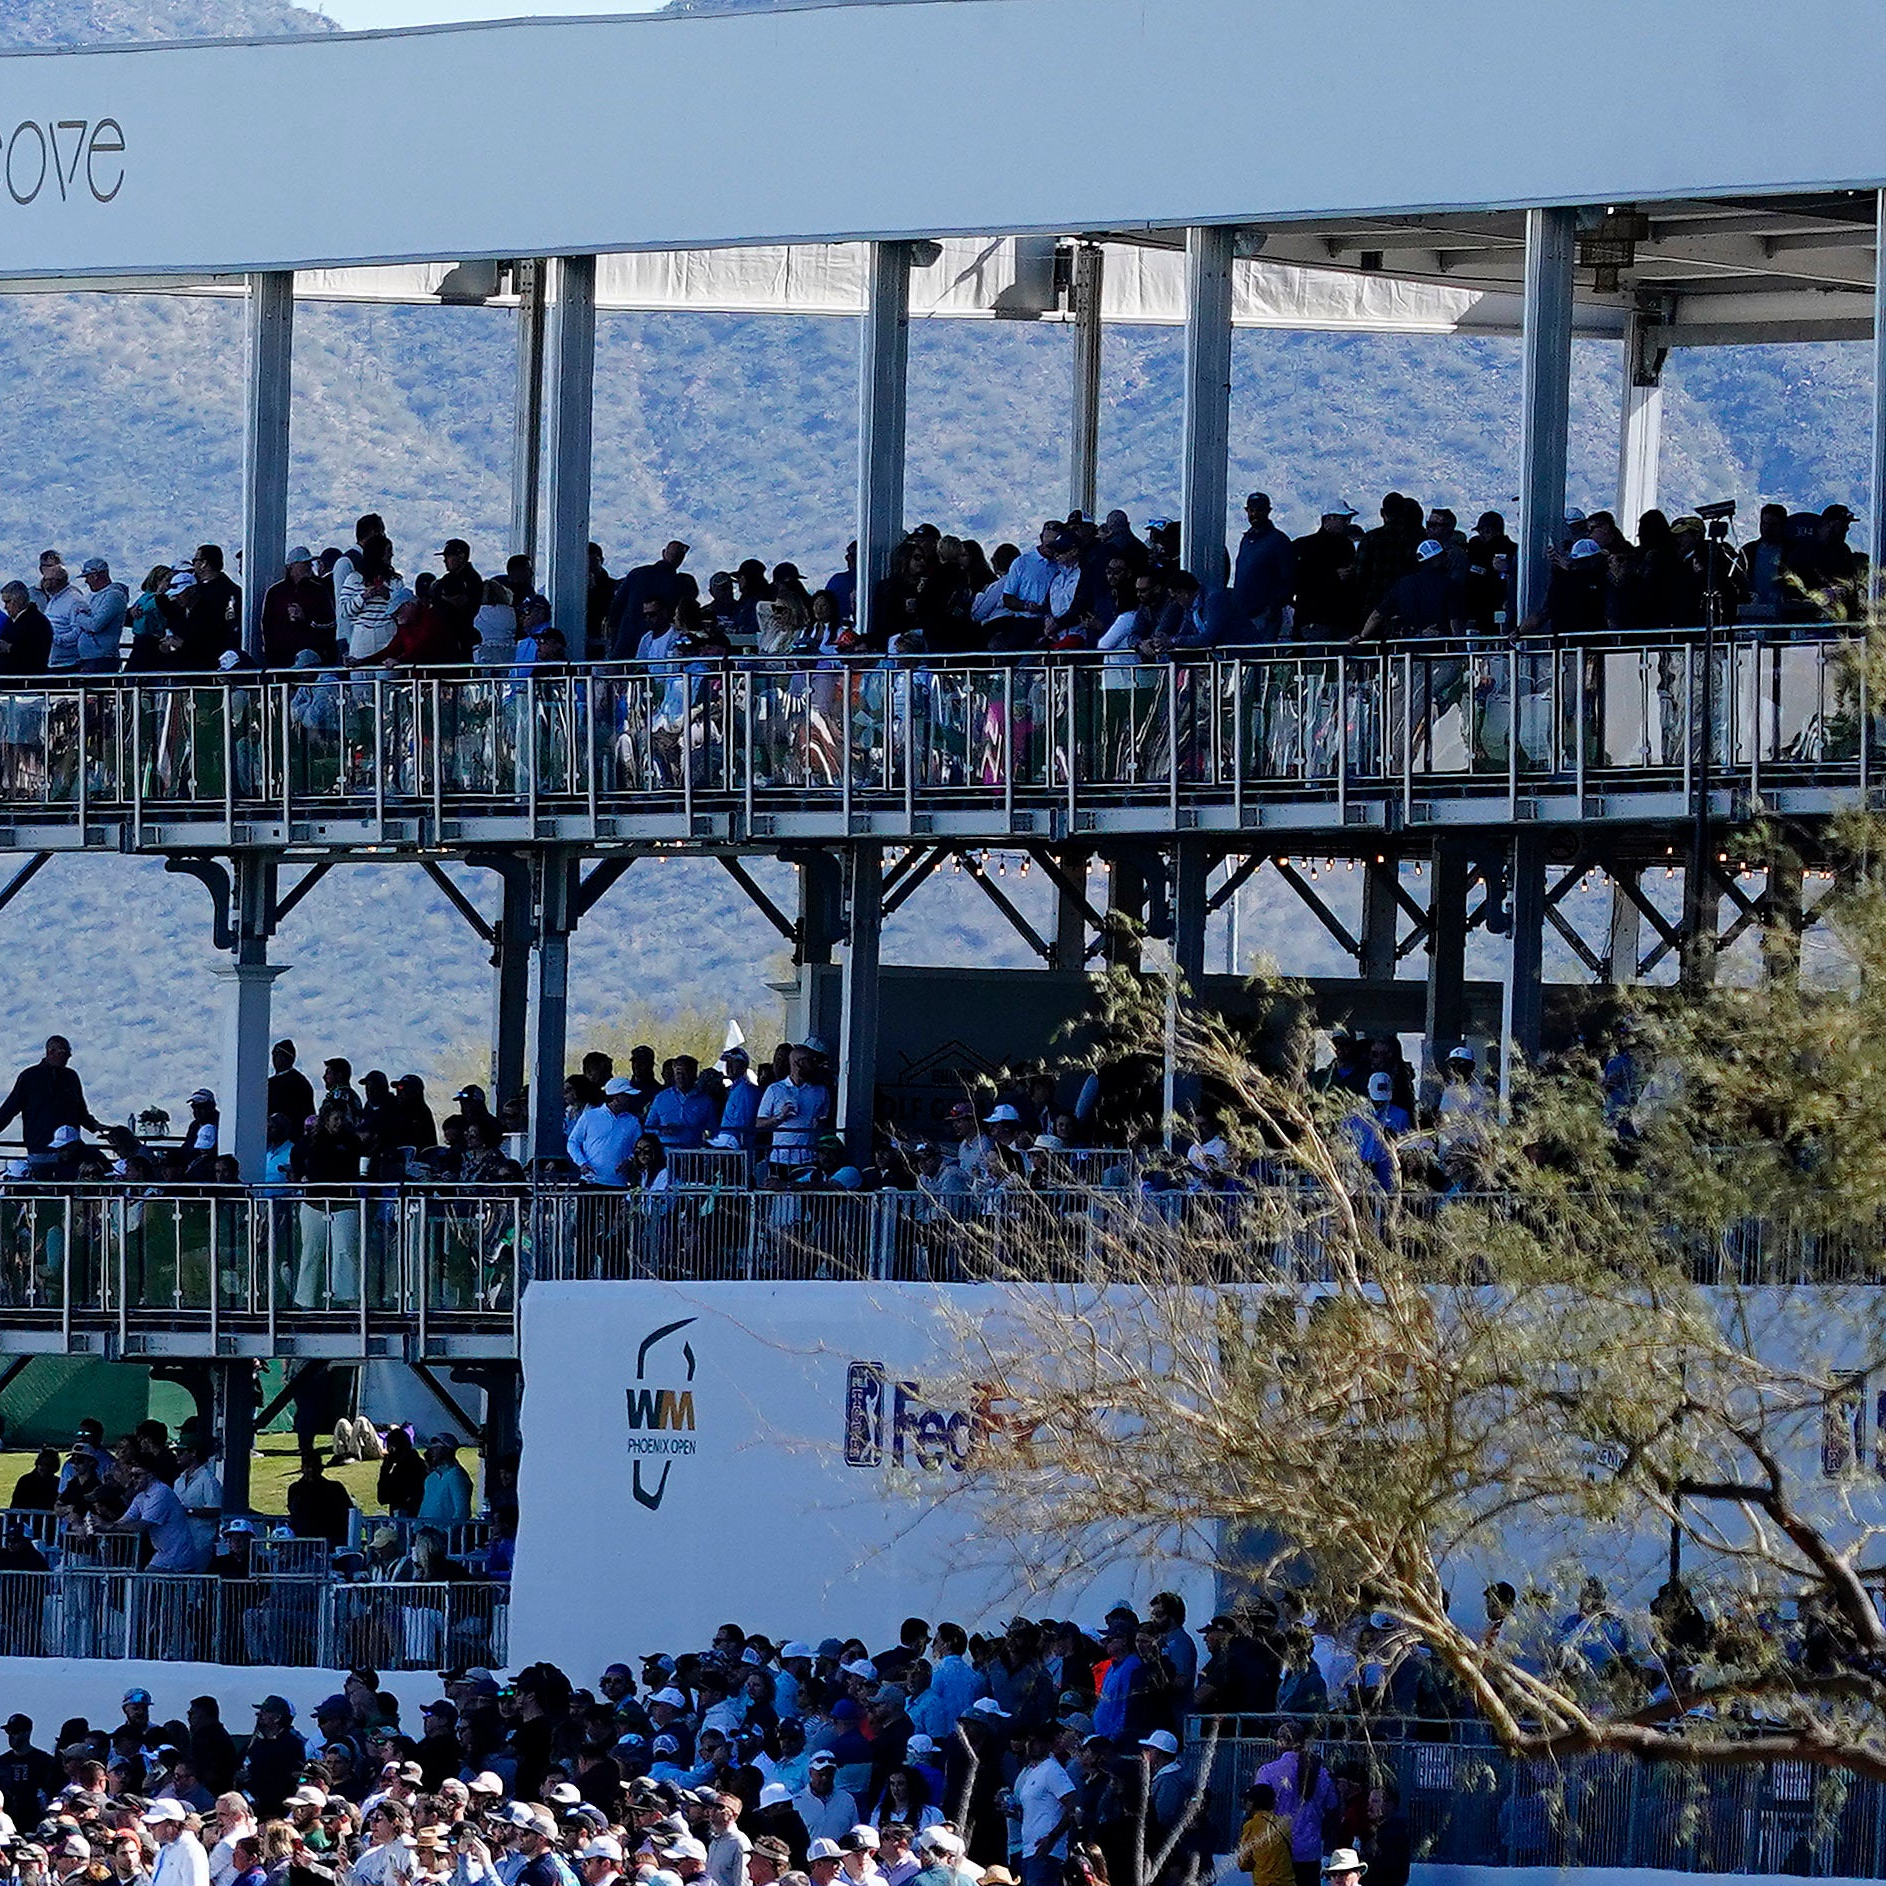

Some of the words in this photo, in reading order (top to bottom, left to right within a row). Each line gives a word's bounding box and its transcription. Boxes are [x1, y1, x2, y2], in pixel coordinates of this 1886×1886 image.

[626, 1388, 696, 1431] WM
[627, 1438, 670, 1455] PHOENIX
[671, 1439, 697, 1455] OPEN
